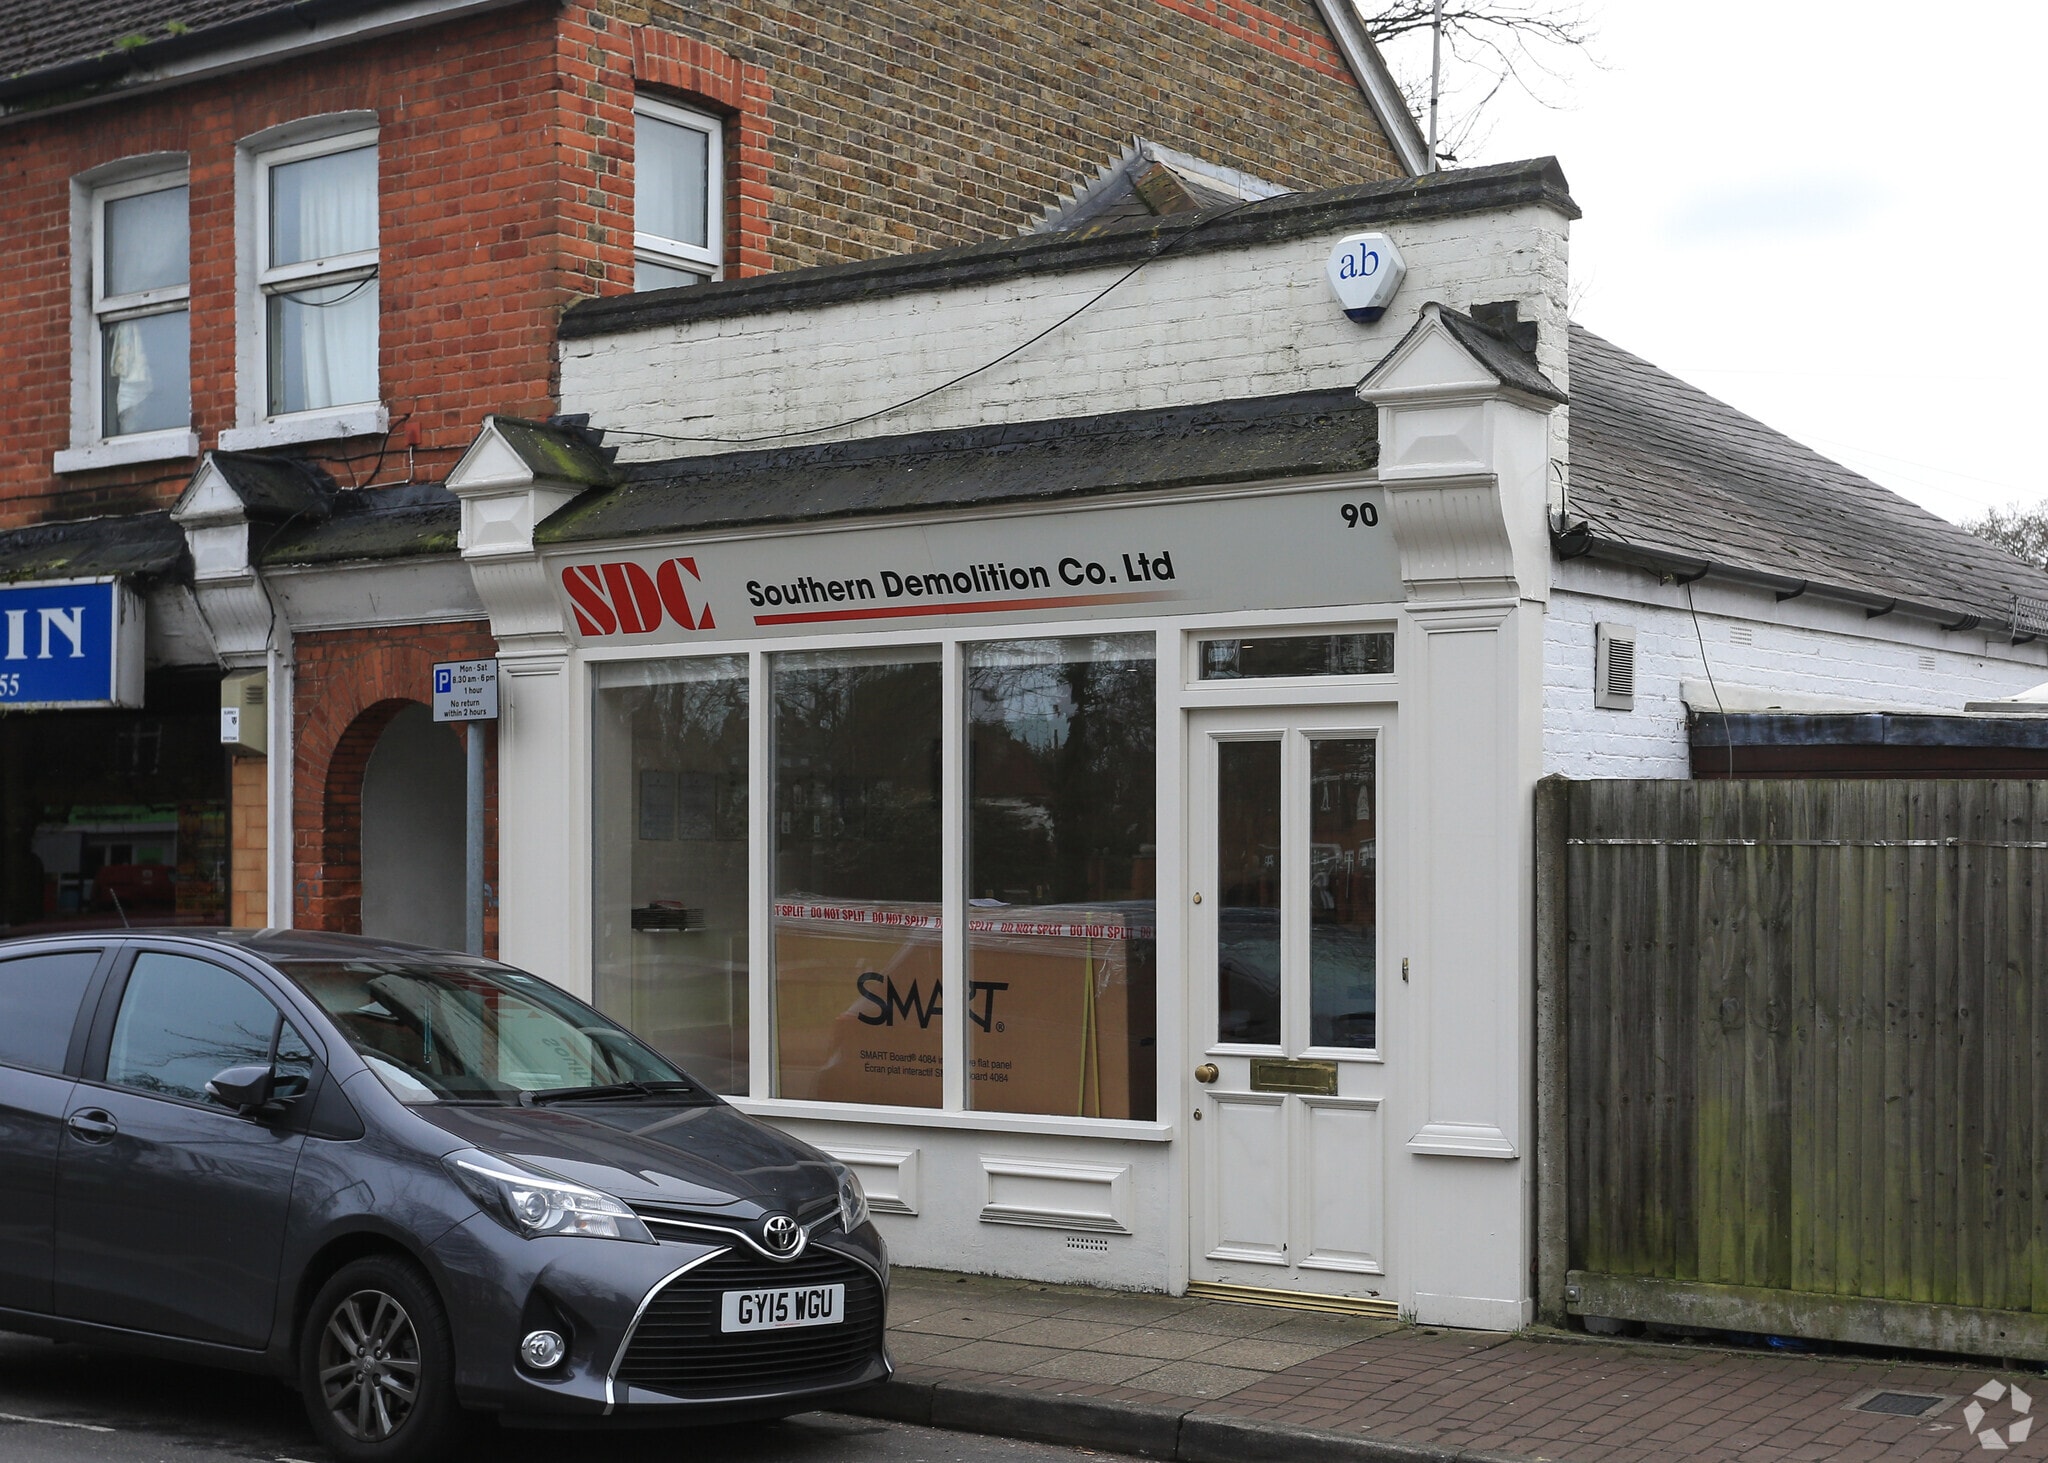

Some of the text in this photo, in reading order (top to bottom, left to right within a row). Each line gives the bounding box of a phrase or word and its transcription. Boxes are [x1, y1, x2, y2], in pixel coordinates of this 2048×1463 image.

[1340, 243, 1379, 280] ab
[1340, 502, 1379, 528] 90
[746, 551, 1176, 607] Southern Demolition Co. Ltd
[561, 556, 716, 636] SDC
[4, 606, 86, 660] IN
[452, 675, 466, 684] 8.30
[481, 674, 485, 682] 6
[460, 665, 472, 673] Mon
[477, 664, 487, 672] Sat
[439, 671, 449, 691] P
[461, 699, 480, 707] return
[469, 708, 486, 716] hours
[783, 906, 805, 918] SPLIT
[811, 906, 822, 918] DO
[824, 908, 840, 920] NOT
[842, 909, 865, 922] SPLIT
[872, 911, 884, 923] DO
[886, 912, 902, 925] NOT
[905, 915, 928, 927] SPLIT
[969, 920, 993, 932] SPLIT
[1001, 922, 1013, 932] DO
[1016, 924, 1034, 934] NOT
[1036, 924, 1062, 935] SPLIT
[1070, 924, 1083, 936] DO
[1085, 925, 1104, 938] NOT
[1107, 927, 1134, 940] SPLIT
[860, 1050, 888, 1060] SMART
[918, 1054, 937, 1064] 4084
[978, 1058, 989, 1068] flat
[991, 1060, 1012, 1070] panel
[888, 1066, 900, 1075] plat
[902, 1066, 933, 1077] interactif
[990, 1073, 1008, 1082] 4084
[738, 1288, 832, 1324] GY15 WGU
